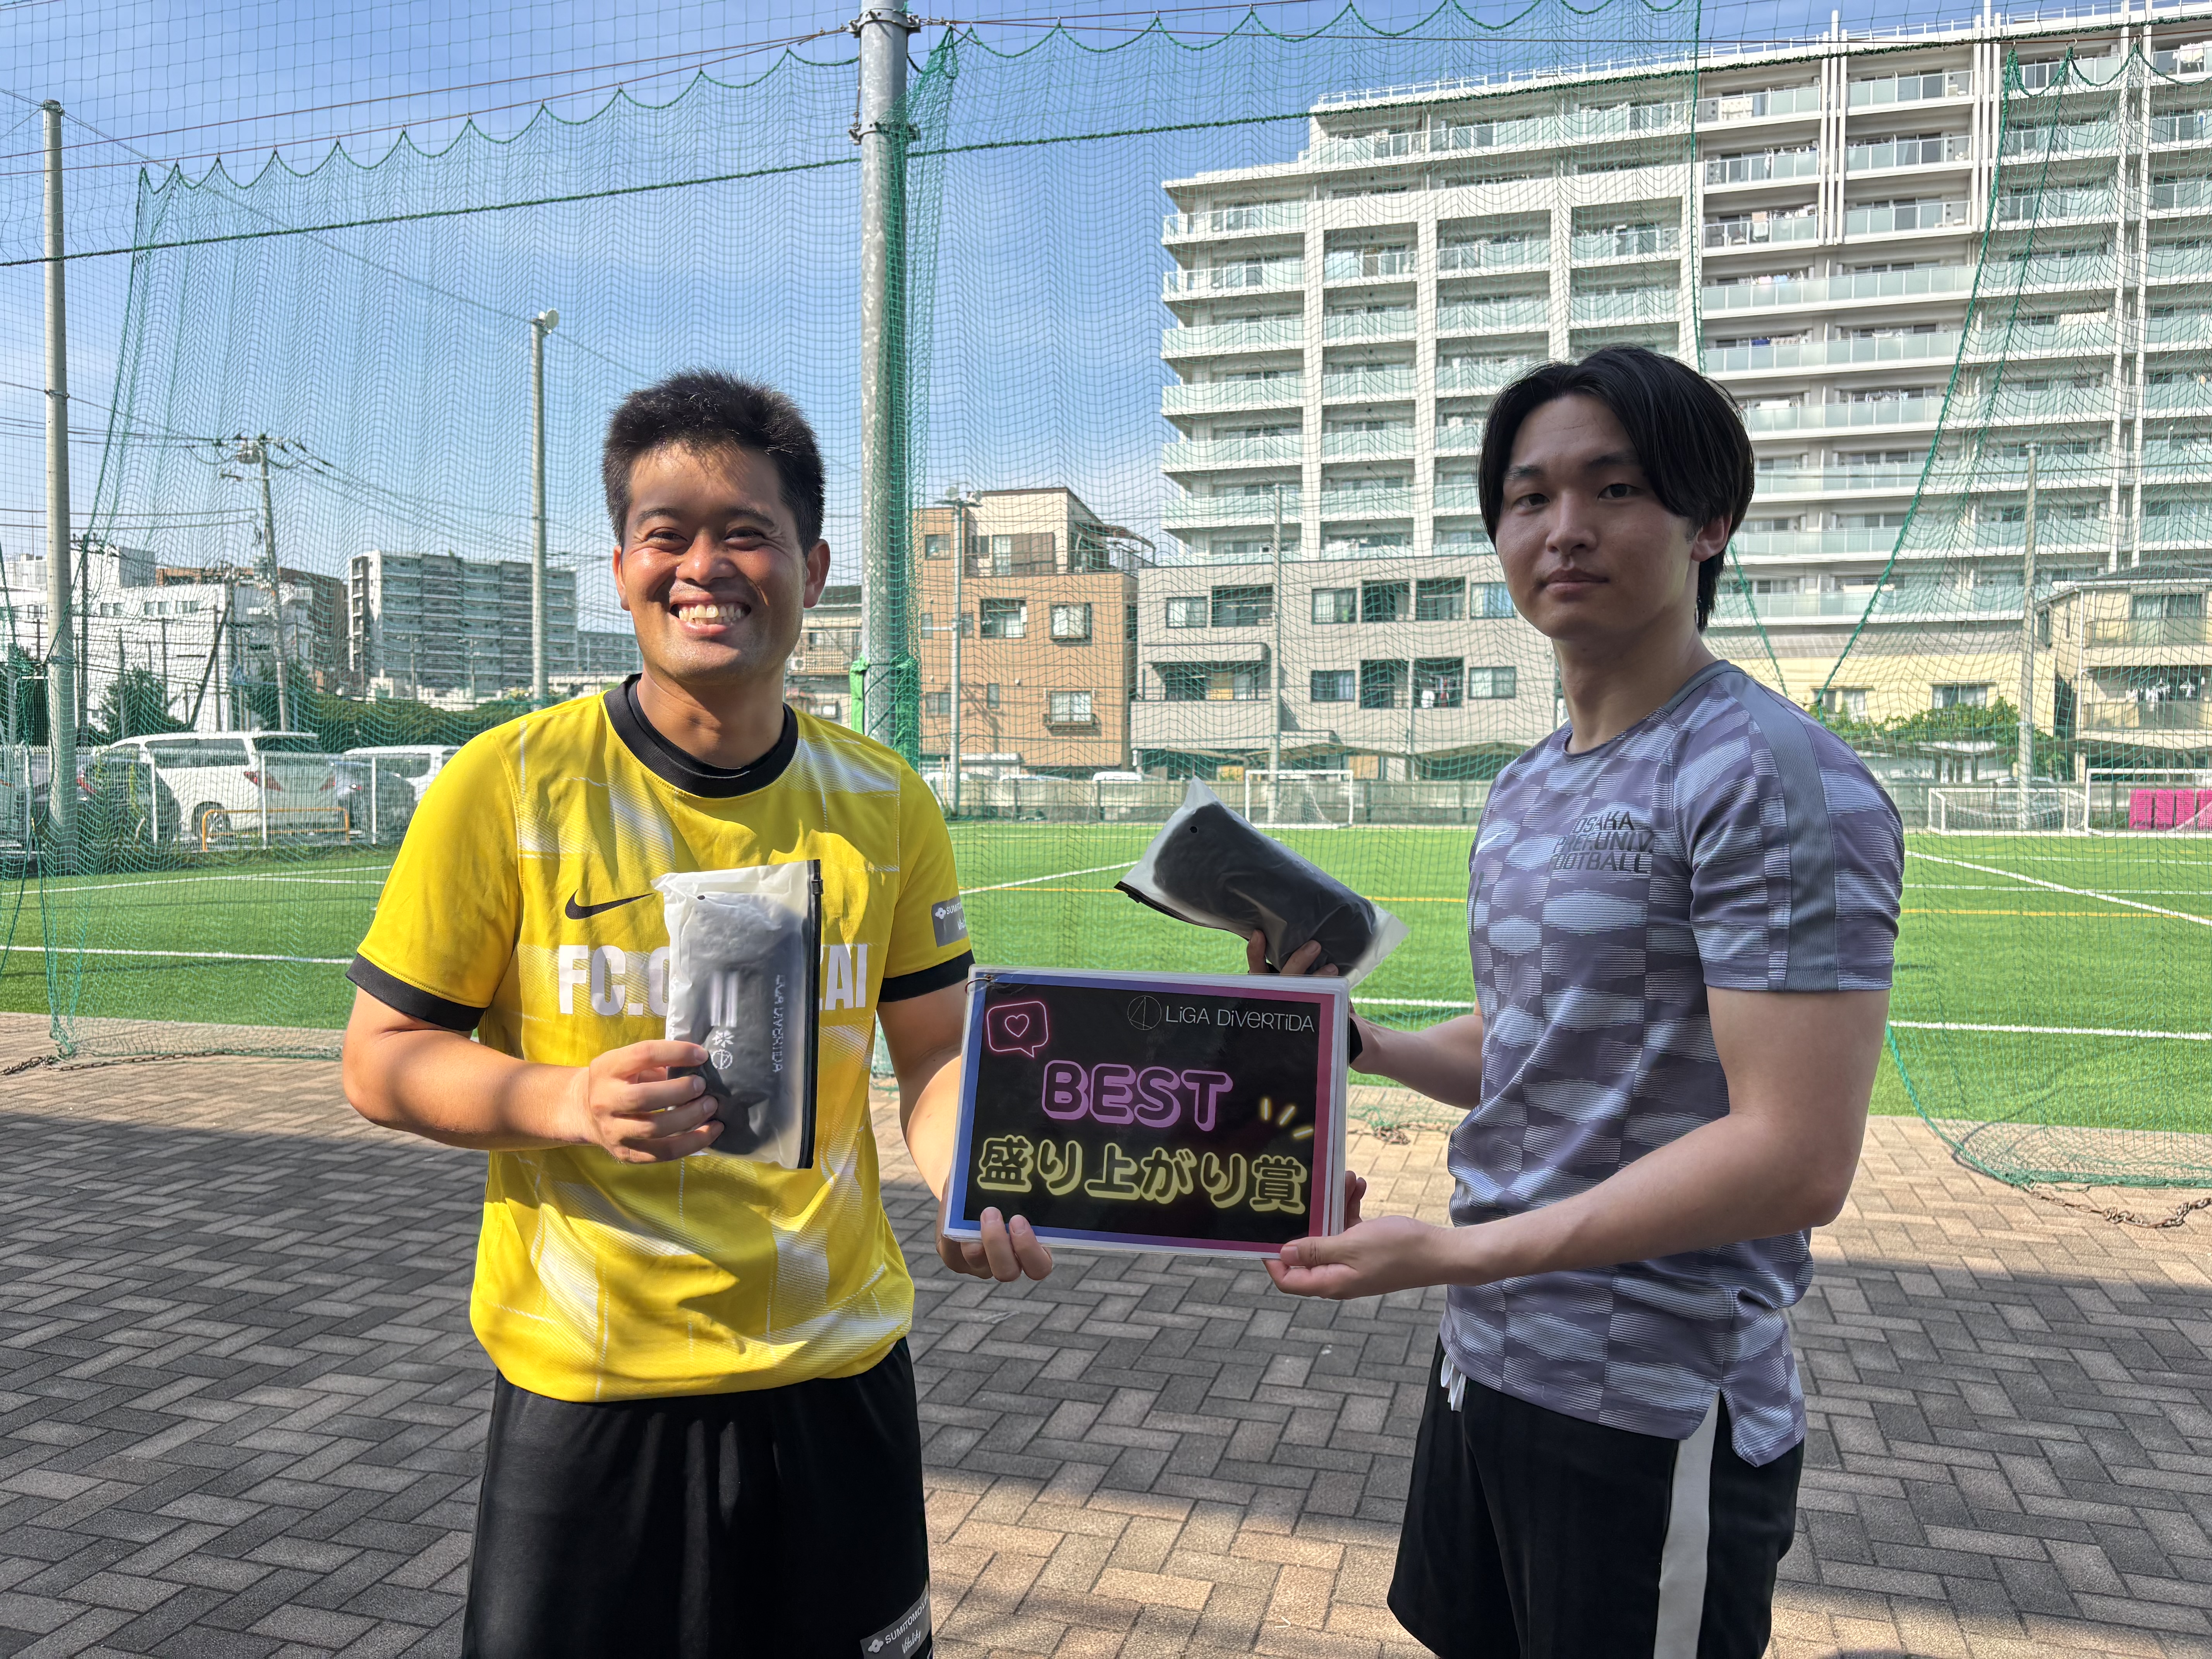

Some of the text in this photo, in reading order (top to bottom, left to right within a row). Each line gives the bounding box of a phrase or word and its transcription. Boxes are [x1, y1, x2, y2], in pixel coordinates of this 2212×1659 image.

[1572, 811, 1635, 833] OSAKA
[1042, 1060, 1233, 1132] BEST
[977, 1134, 1307, 1215] 盛り上がり賞
